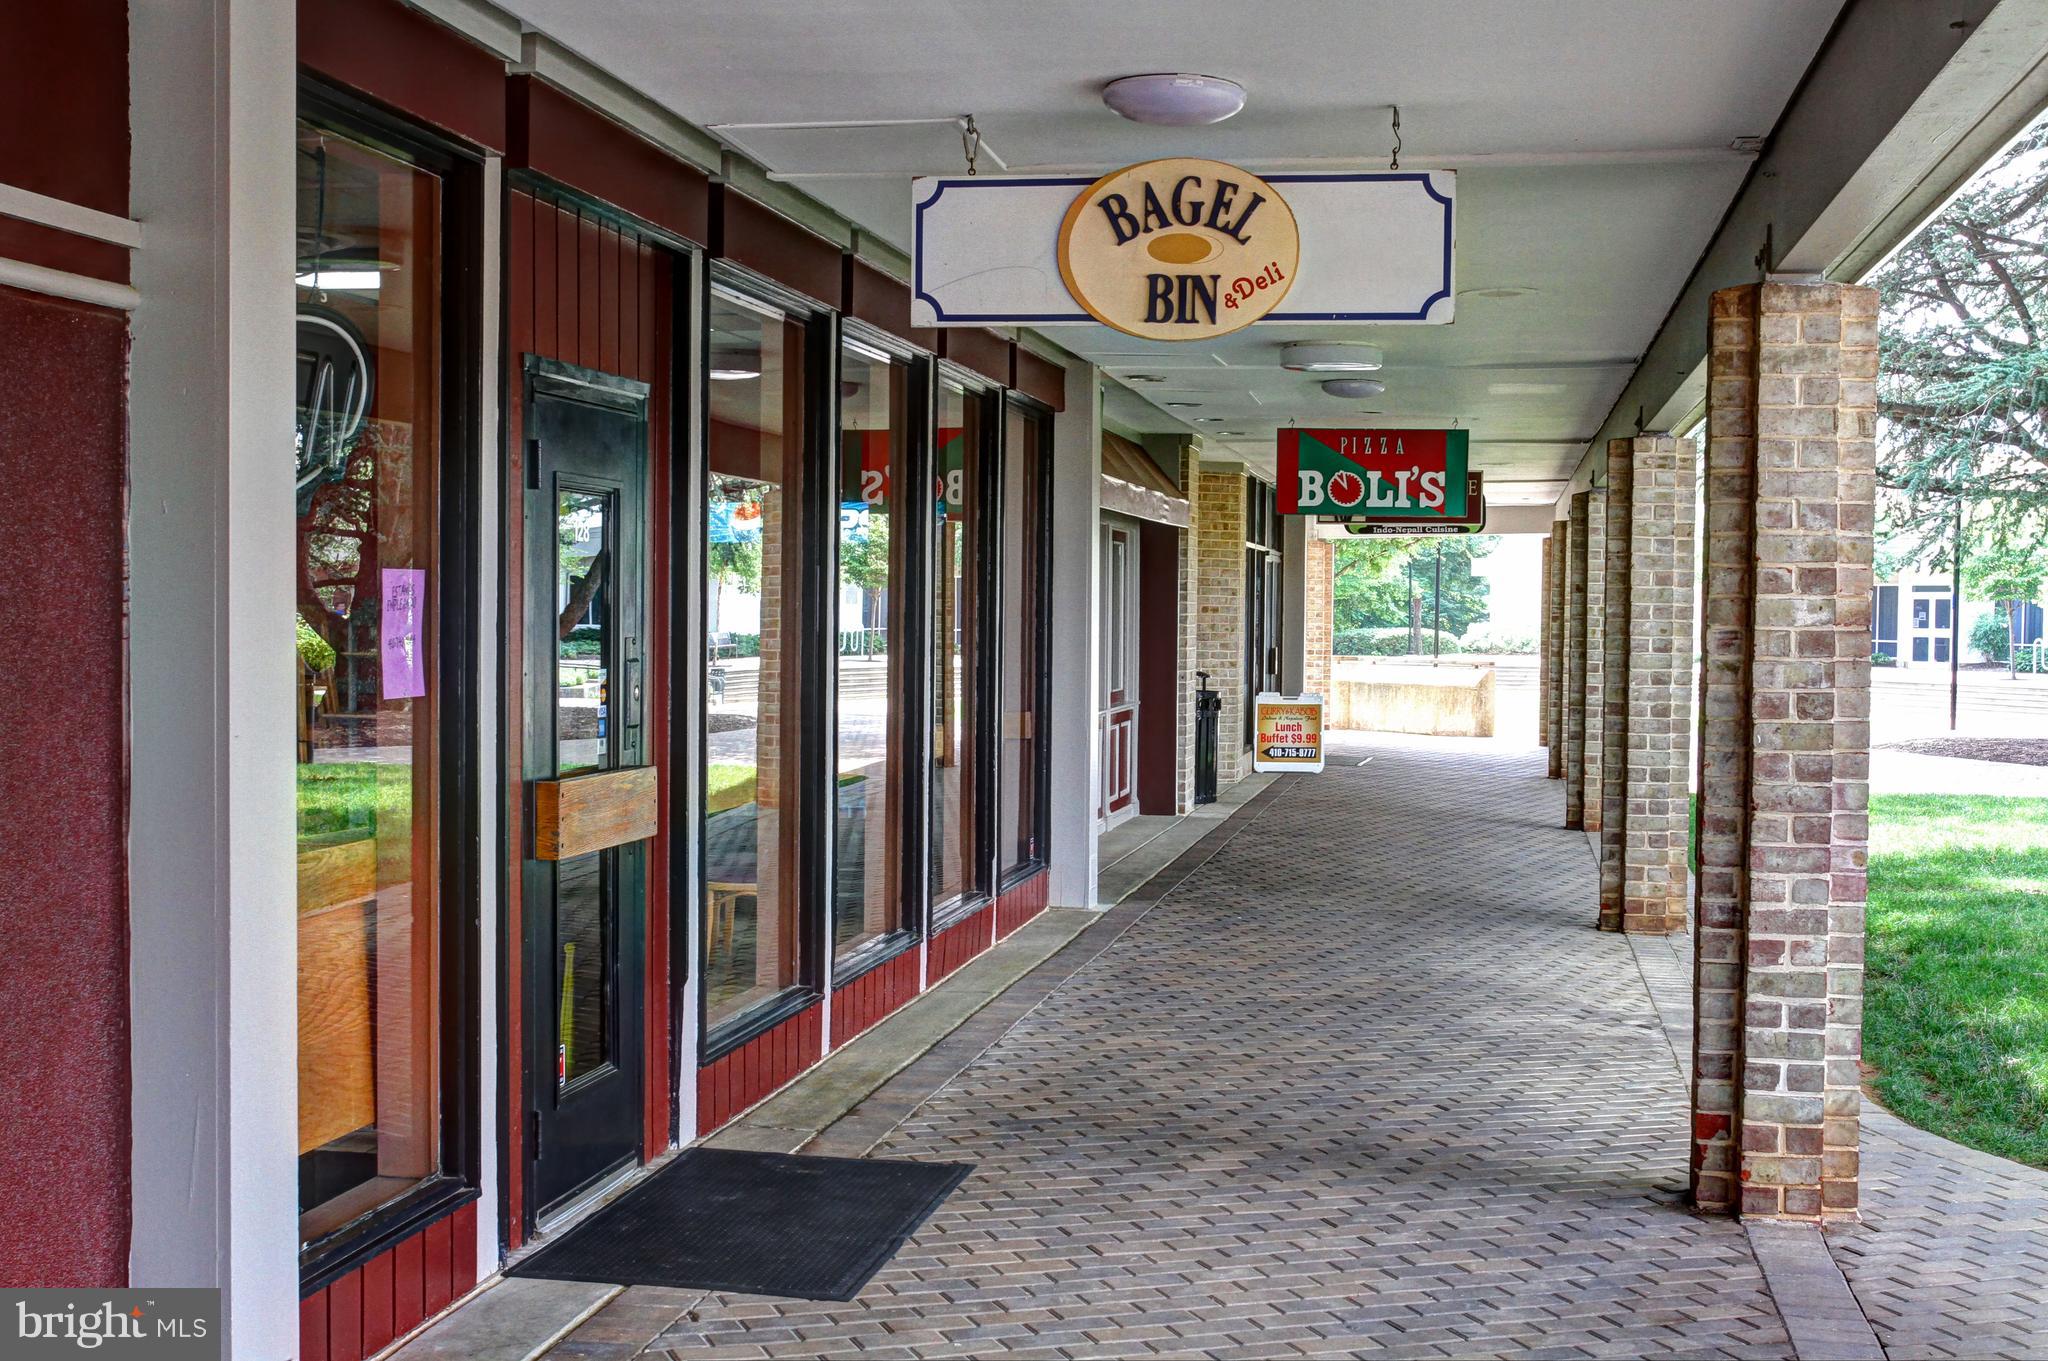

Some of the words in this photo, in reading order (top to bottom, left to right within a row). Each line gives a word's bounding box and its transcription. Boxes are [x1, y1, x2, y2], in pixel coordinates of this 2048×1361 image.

[1097, 175, 1267, 246] BAGEL
[1144, 273, 1222, 325] BIN
[1340, 437, 1405, 455] PIZZA
[1298, 465, 1446, 508] BOLI'S
[1425, 526, 1459, 534] Cuisine
[1275, 722, 1303, 732] Lunch
[1260, 733, 1289, 744] Buffet
[1291, 733, 1317, 744] $9.99
